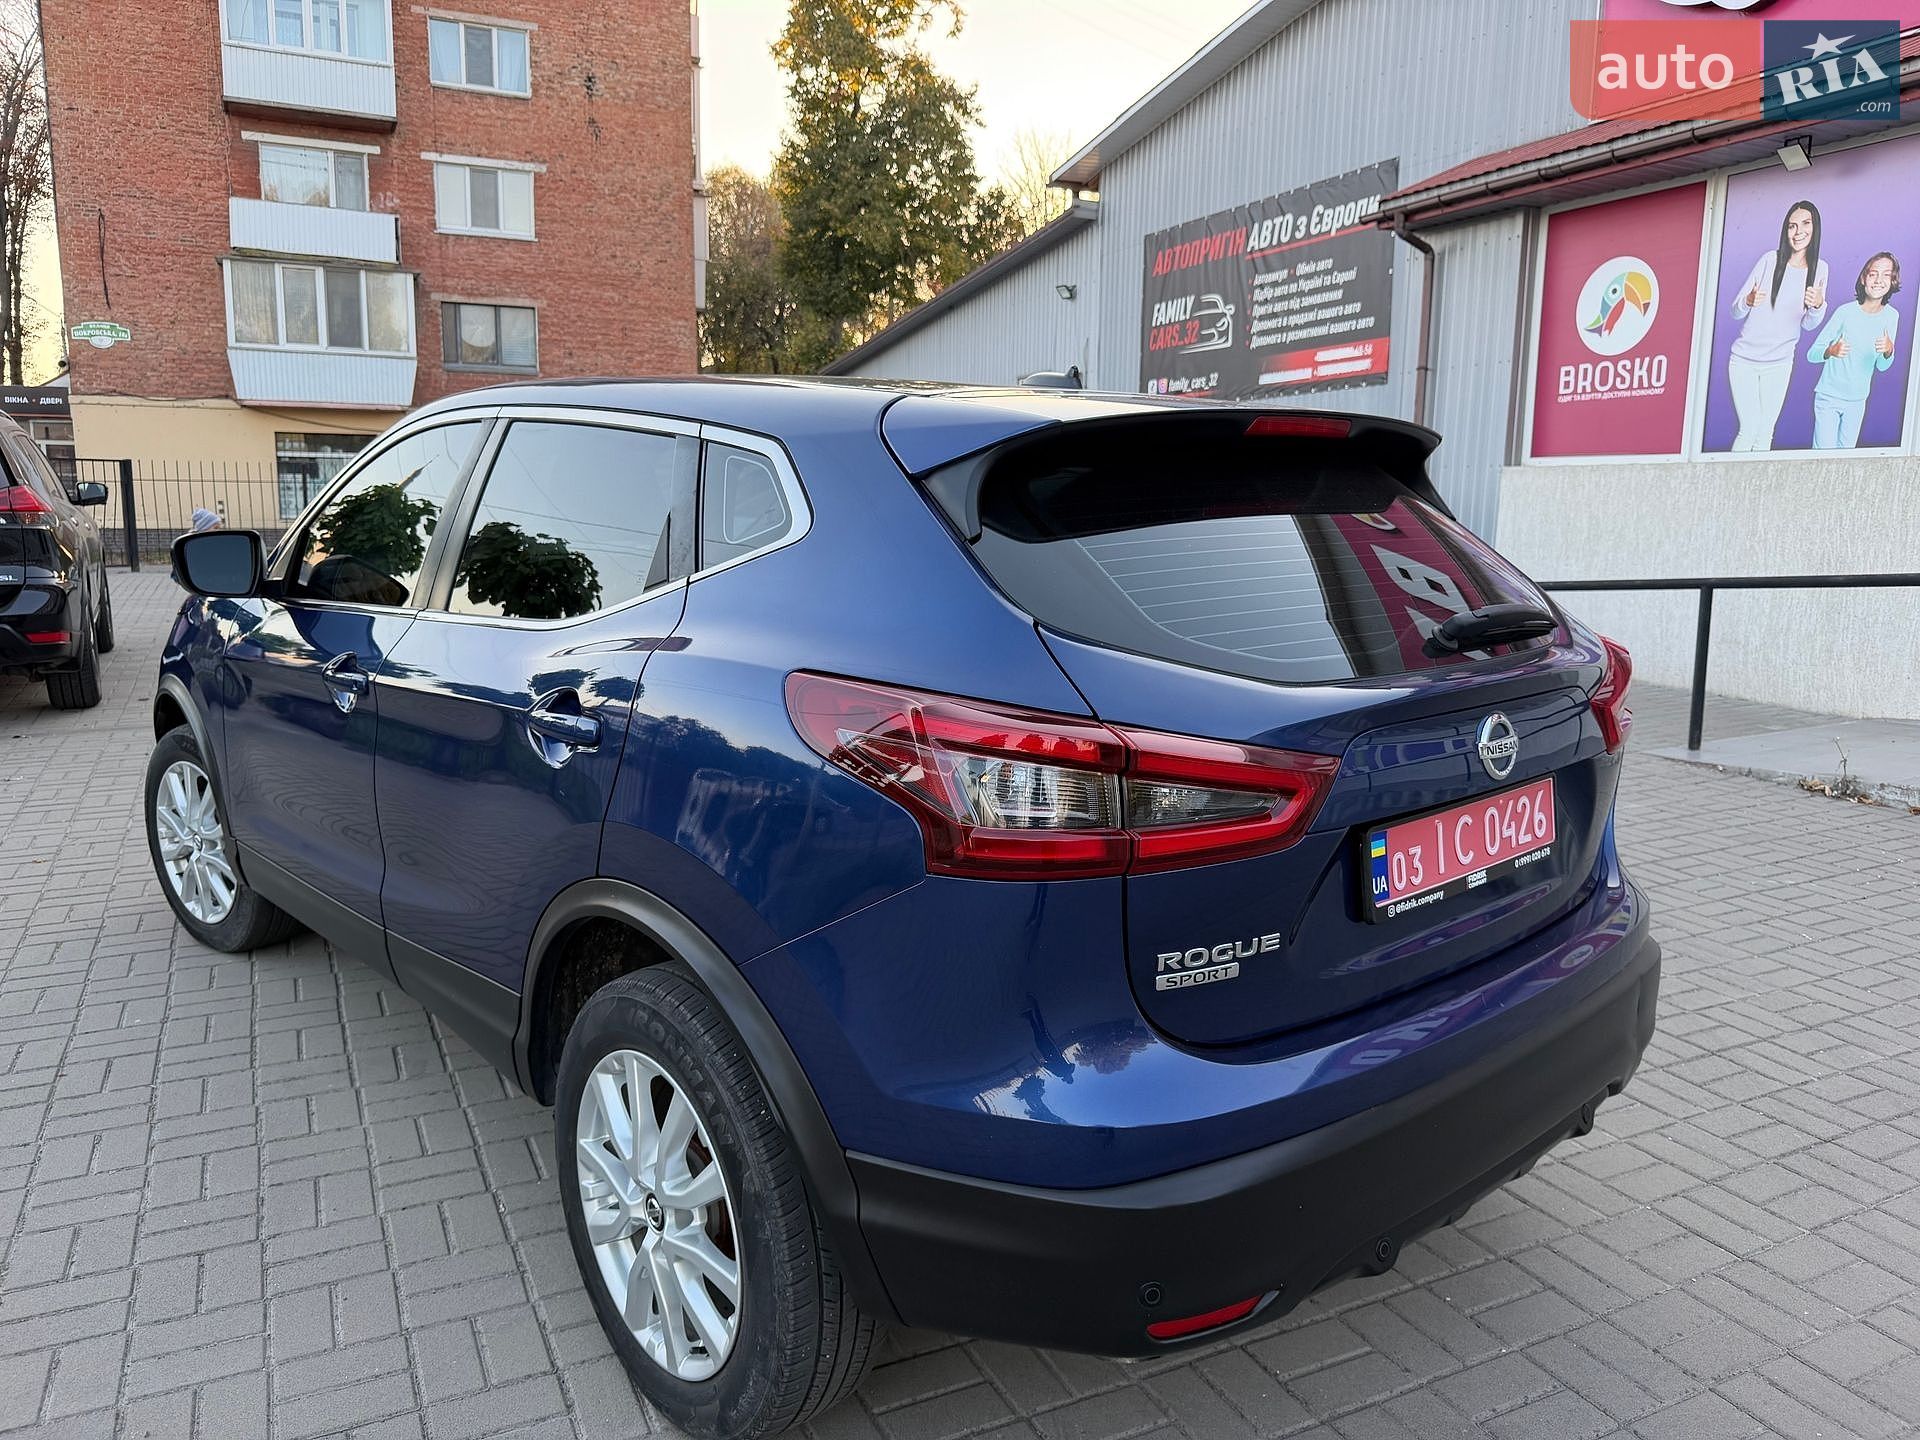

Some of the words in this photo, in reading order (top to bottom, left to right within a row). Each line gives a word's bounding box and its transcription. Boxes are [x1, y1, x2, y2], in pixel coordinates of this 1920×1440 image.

[1152, 226, 1249, 278] АВТОПРИГІН
[1247, 212, 1294, 252] АВТО
[1295, 215, 1308, 240] з
[1152, 294, 1195, 327] FAMILY
[1558, 355, 1668, 395] BROSKO
[4, 396, 29, 404] ВІКНА
[40, 397, 63, 405] ДВЕРІ
[1486, 739, 1519, 755] NISSAN
[1392, 846, 1424, 891] 03
[1484, 790, 1547, 856] 0426
[1372, 878, 1388, 895] UA
[1468, 870, 1487, 884] FIDRIK
[1396, 890, 1444, 914] @fidrik.company
[1157, 932, 1280, 972] ROGUE
[1166, 966, 1233, 988] SPORT
